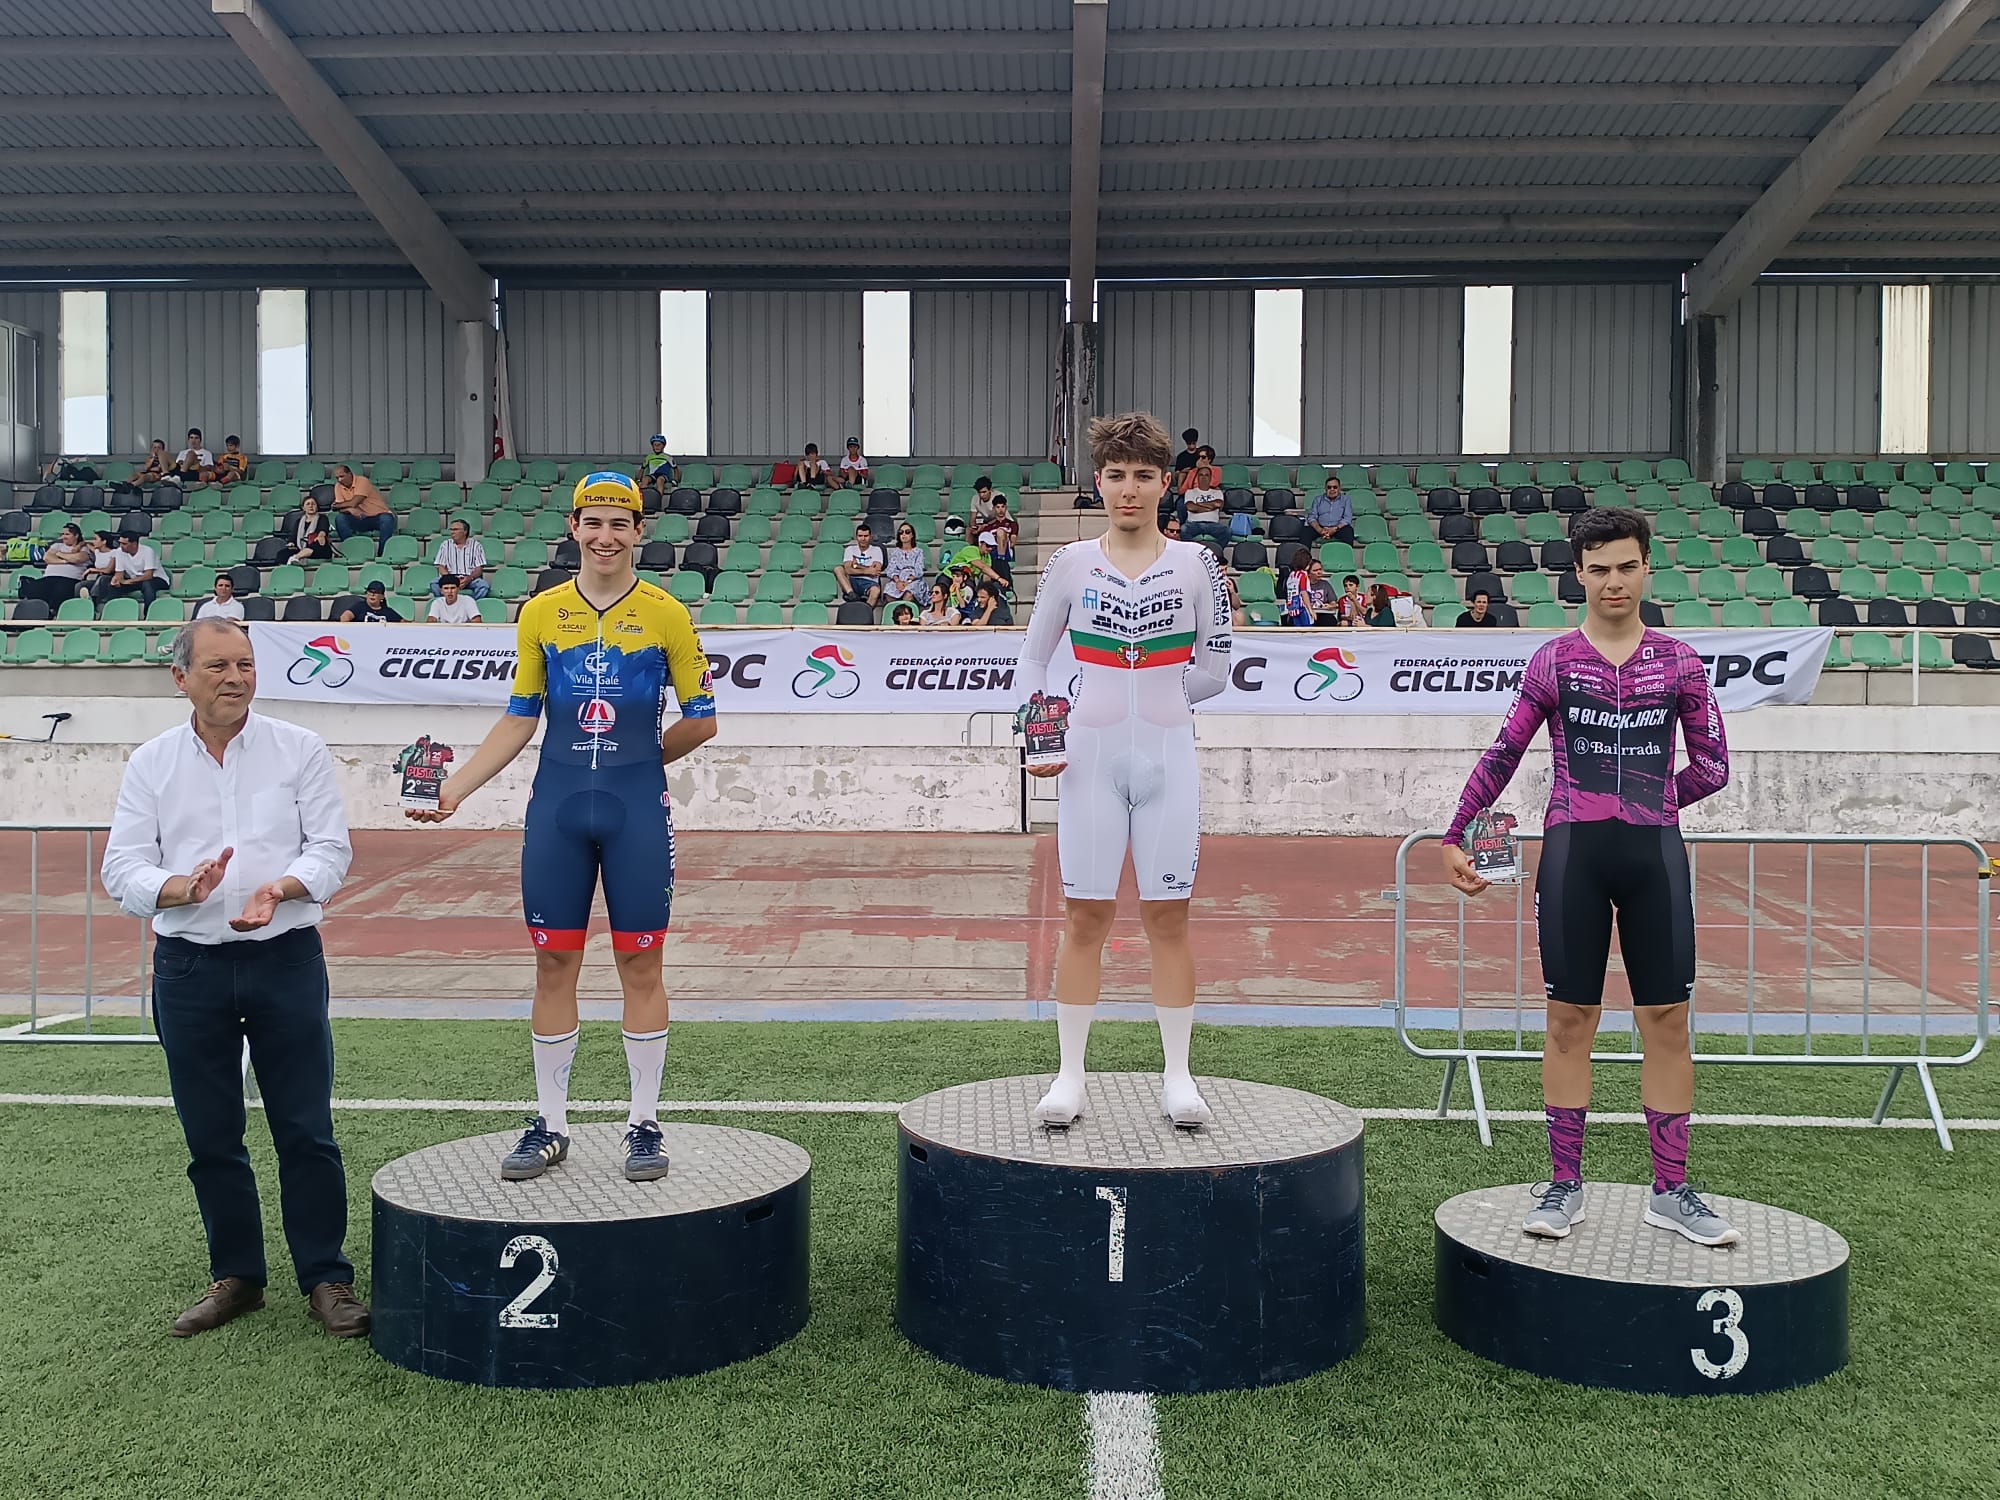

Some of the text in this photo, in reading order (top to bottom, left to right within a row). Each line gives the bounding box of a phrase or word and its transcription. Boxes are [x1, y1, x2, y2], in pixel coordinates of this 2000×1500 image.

[1140, 588, 1184, 604] MUNICIPAL
[1100, 598, 1183, 621] PAREDES
[385, 647, 518, 658] FEDERAÇÃO PORTUGUES
[890, 656, 1018, 668] FEDERAÇÃO PORTUGUES
[1393, 657, 1527, 669] FEDERAÇÃO PORTUGUES
[576, 674, 620, 685] Vila Galé
[885, 668, 1016, 691] CICLISM
[1389, 669, 1522, 692] CICLISM
[1581, 708, 1668, 729] BLACKJACK
[1027, 723, 1060, 735] PISTA
[1590, 741, 1662, 756] Bairrada
[1095, 1186, 1127, 1282] 1
[499, 1234, 559, 1328] 2
[1690, 1288, 1749, 1379] 3
